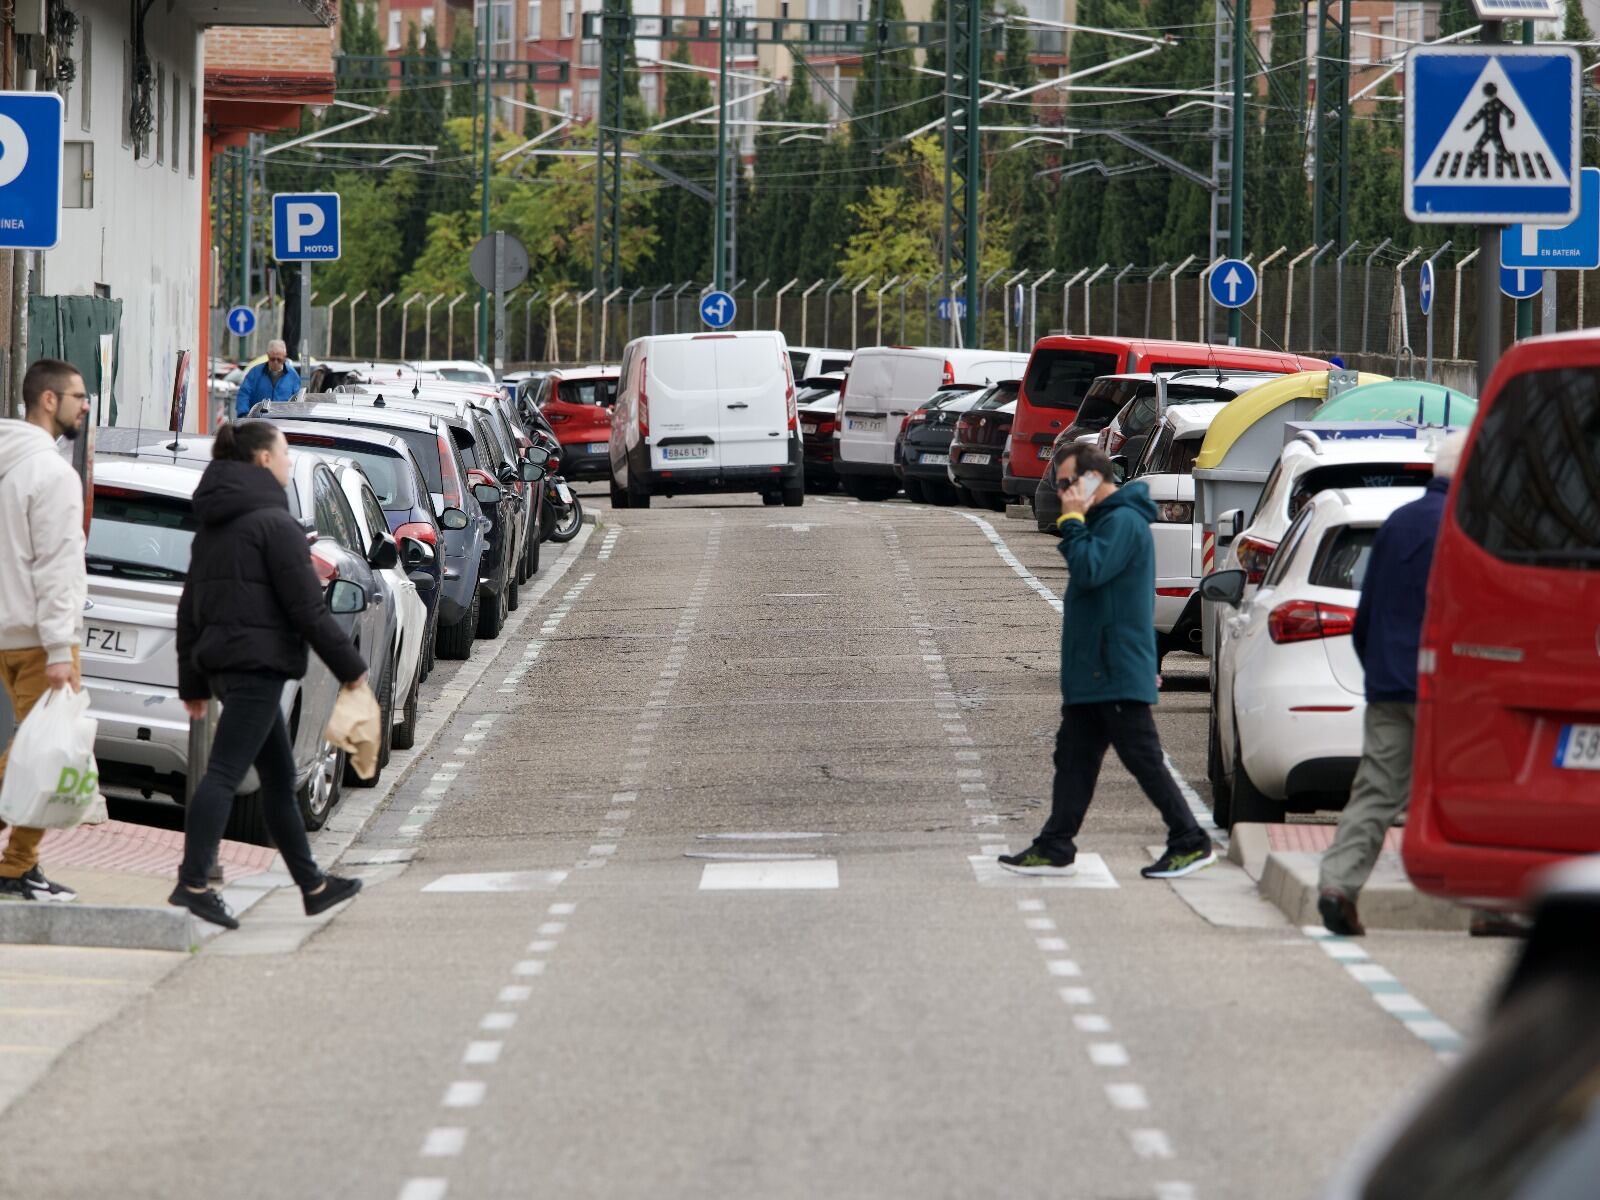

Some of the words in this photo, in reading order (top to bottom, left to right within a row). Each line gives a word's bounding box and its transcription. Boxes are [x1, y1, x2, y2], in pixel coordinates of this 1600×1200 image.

[287, 203, 325, 252] P
[1552, 248, 1580, 256] BATERÍA
[691, 447, 708, 456] LTH
[86, 627, 127, 653] FZL
